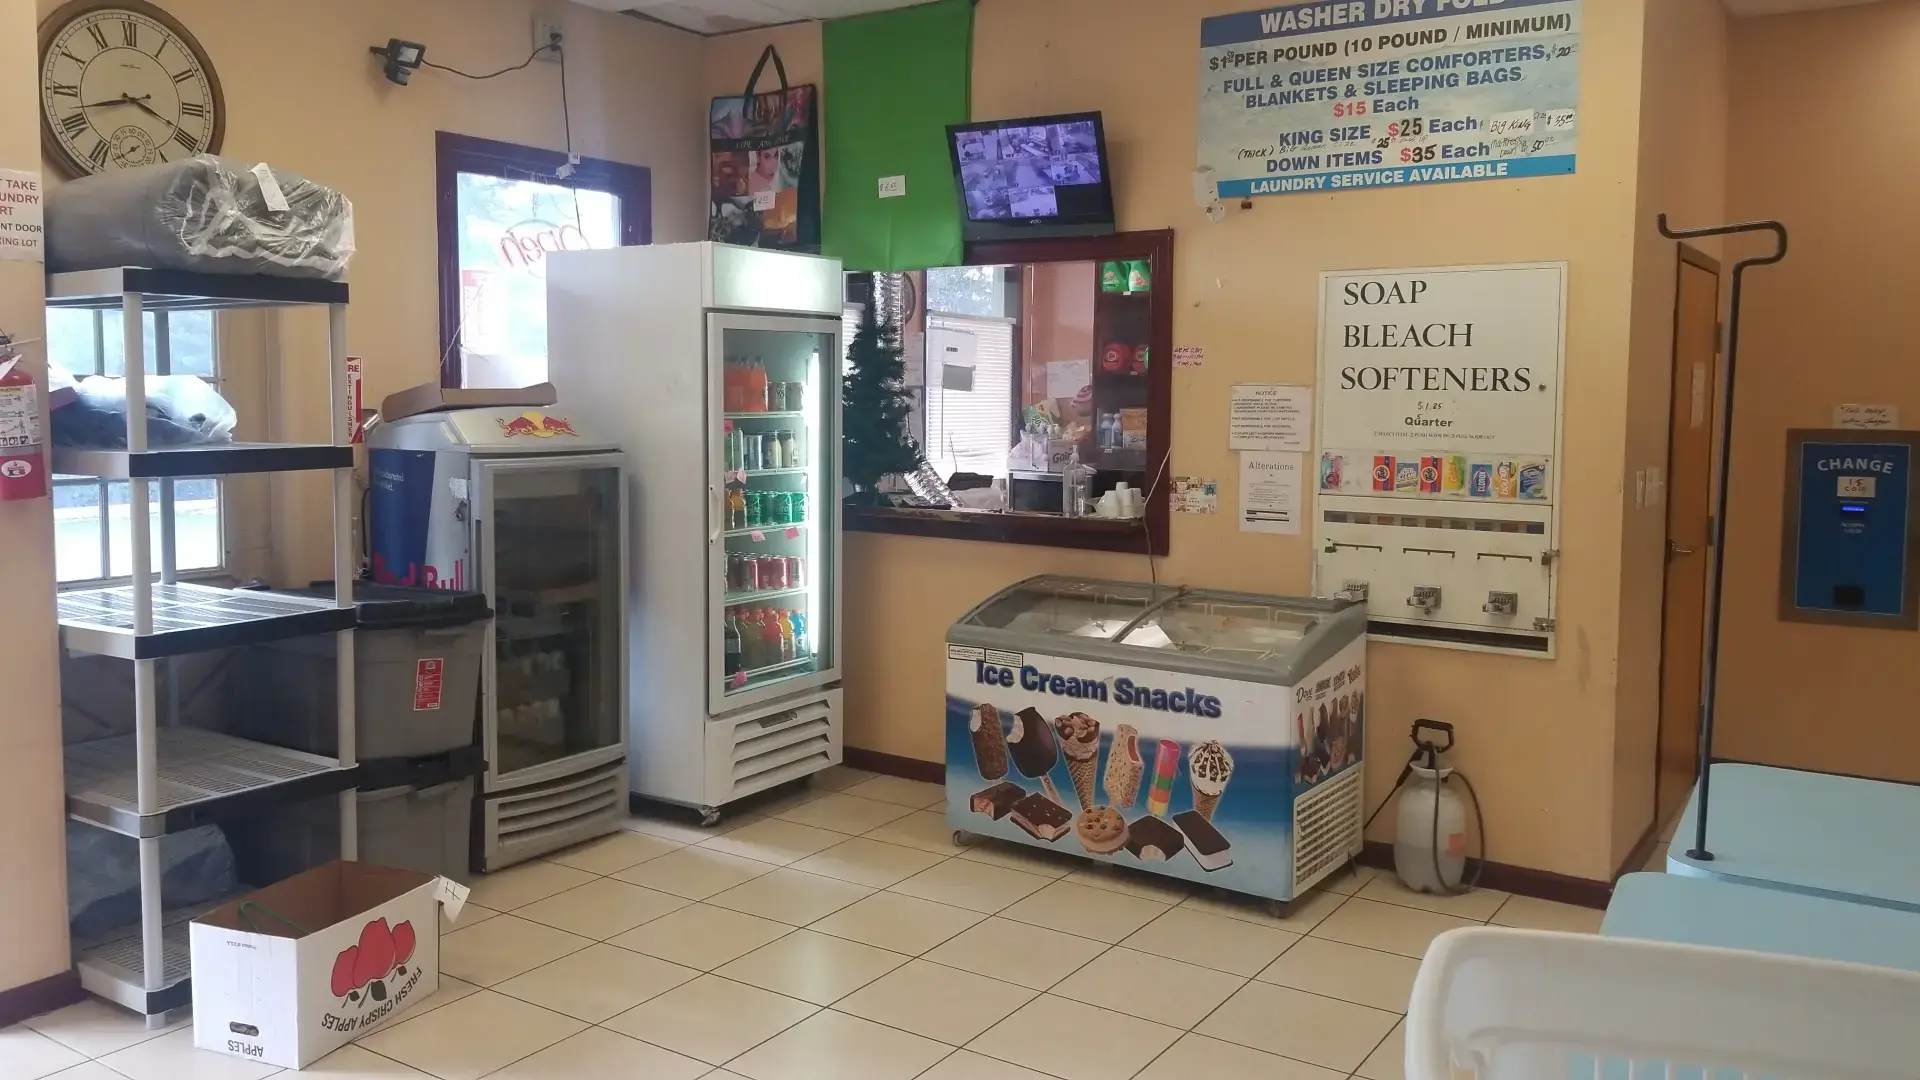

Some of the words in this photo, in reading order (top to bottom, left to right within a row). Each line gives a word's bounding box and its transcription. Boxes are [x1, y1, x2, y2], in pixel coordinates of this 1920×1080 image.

[1260, 2, 1365, 34] WASHER
[1374, 0, 1425, 19] DRY
[1235, 50, 1268, 68] PER
[1273, 42, 1337, 62] POUND
[1344, 37, 1372, 57] (10
[1378, 28, 1447, 50] POUND
[1466, 13, 1572, 40] MINIMUM)
[1223, 77, 1265, 94] FULL
[1270, 73, 1283, 88] &
[1289, 66, 1351, 86] QUEEN
[1357, 60, 1400, 79] SIZE
[1406, 44, 1551, 72] COMFORTERS,
[1246, 86, 1338, 108] BLANKETS
[1344, 84, 1357, 99] &
[1364, 73, 1459, 96] SLEEPING
[1334, 100, 1367, 119] $15
[1373, 96, 1419, 114] Each
[1279, 129, 1324, 147] KING
[1330, 125, 1371, 142] SIZE
[1429, 116, 1478, 134] Each
[1267, 154, 1320, 173] DOWN
[1326, 150, 1383, 168] ITEMS
[1400, 144, 1437, 163] $35
[1441, 141, 1490, 159] Each
[6, 179, 36, 191] TAKE
[1251, 176, 1326, 194] LAUNDRY
[1331, 170, 1404, 188] SERVICE
[1409, 162, 1508, 181] AVAILABLE
[15, 223, 42, 233] DOOR
[21, 239, 37, 247] LOT
[1343, 280, 1427, 306] SOAP
[1342, 323, 1474, 348] BLEACH
[1341, 367, 1531, 392] SOFTENERS
[1405, 416, 1454, 427] Quarter
[1248, 462, 1294, 471] Alterations
[1817, 457, 1895, 474] CHANGE
[975, 659, 1015, 688] Ice
[1019, 664, 1109, 704] Cream
[1113, 677, 1223, 719] Snacks
[395, 966, 423, 1005] FRESH
[321, 1013, 358, 1032] APPLES
[358, 1000, 393, 1029] CRISPY
[228, 1040, 263, 1058] APPLES
